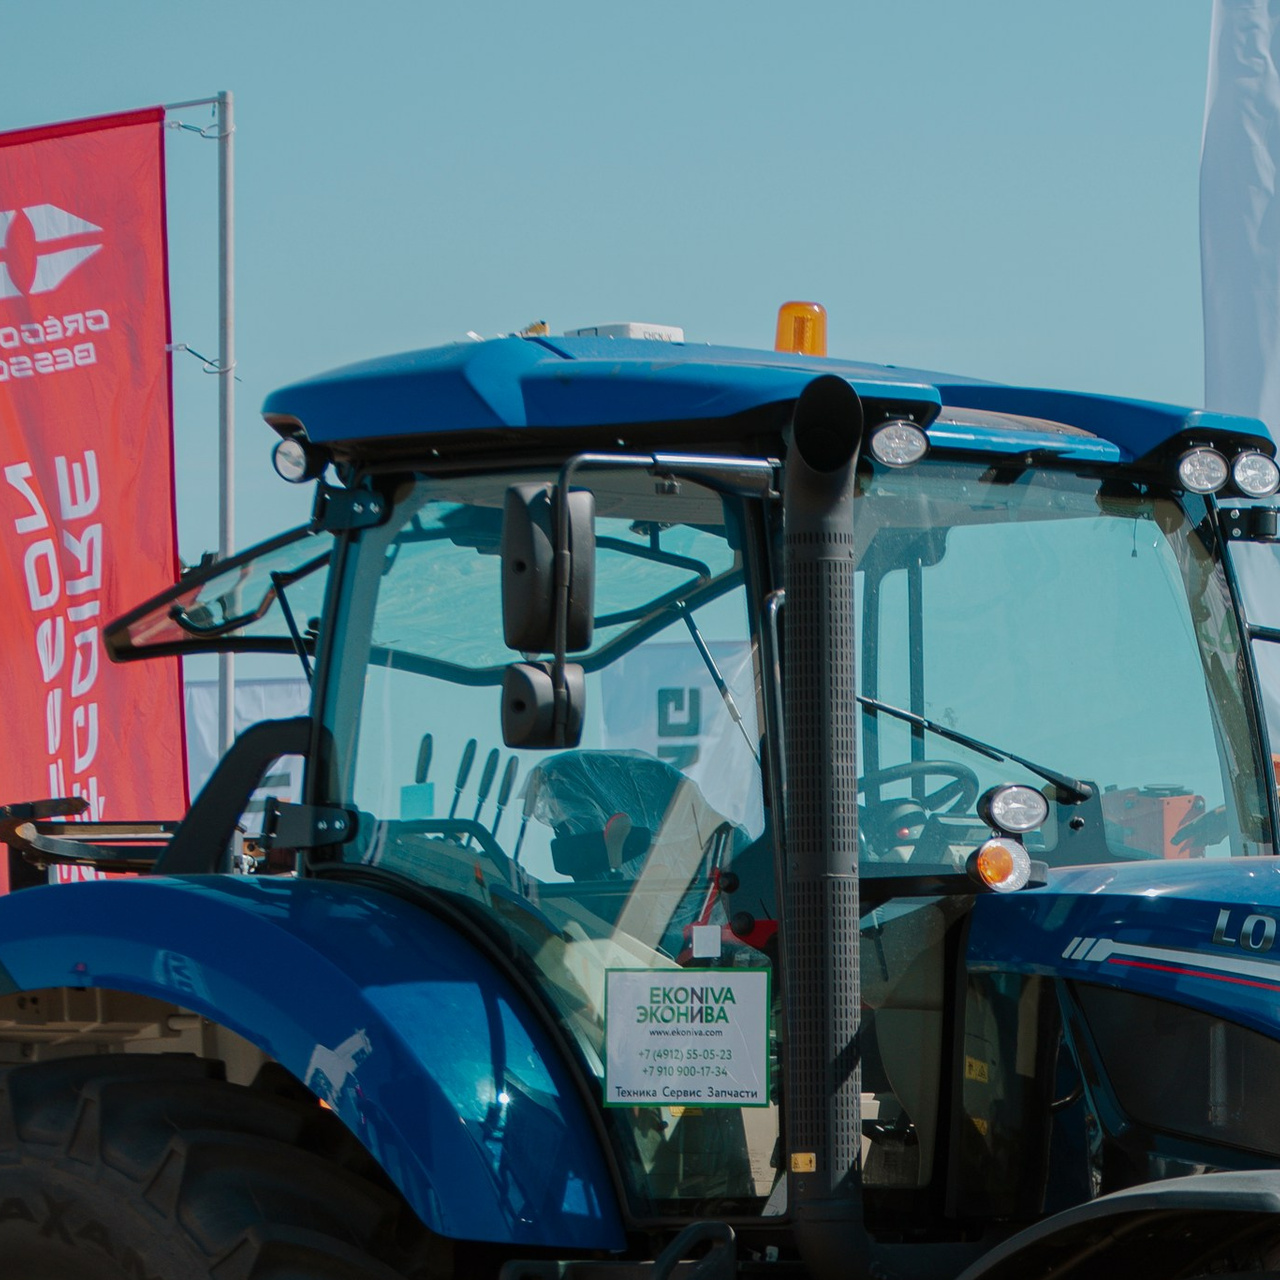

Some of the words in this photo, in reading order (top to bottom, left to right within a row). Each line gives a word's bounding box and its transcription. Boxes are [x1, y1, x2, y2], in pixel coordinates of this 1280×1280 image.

[649, 986, 737, 1005] EKONIVA
[636, 1005, 729, 1024] ЭКОНИВА
[649, 1028, 723, 1037] www.ekoniva.com
[638, 1050, 650, 1060] +7
[652, 1049, 684, 1062] (4912)
[686, 1049, 733, 1060] 55-05-23
[642, 1066, 654, 1077] +7
[656, 1066, 674, 1077] 910
[676, 1066, 728, 1077] 900-17-34
[615, 1086, 657, 1098] Техника
[662, 1086, 702, 1099] Сервис
[707, 1086, 758, 1099] Запчасти
